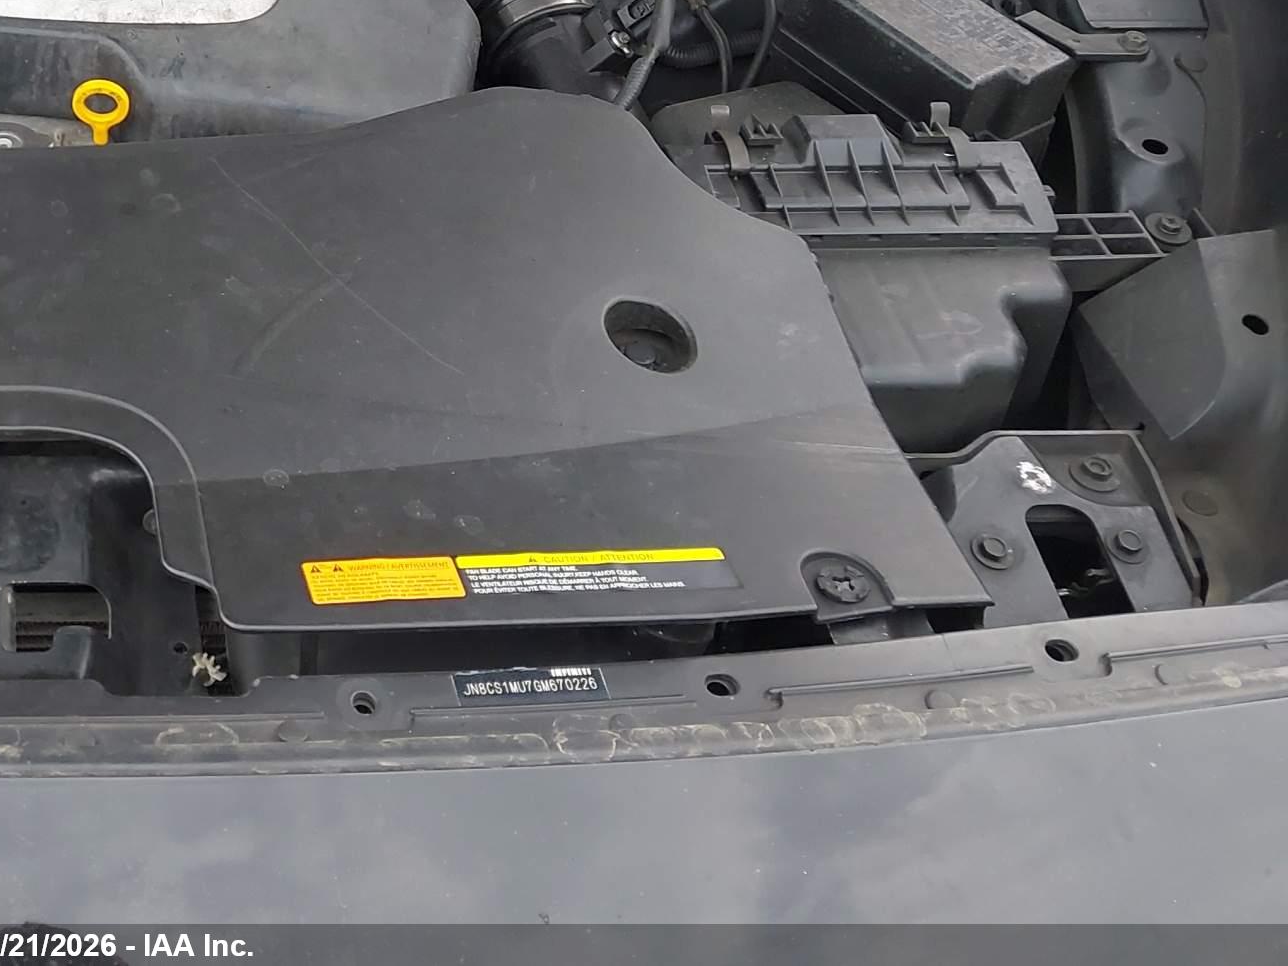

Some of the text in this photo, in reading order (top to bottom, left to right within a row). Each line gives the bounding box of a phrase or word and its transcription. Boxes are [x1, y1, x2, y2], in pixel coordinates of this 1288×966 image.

[543, 555, 588, 563] CAUTION
[600, 553, 655, 562] ATTENTION
[391, 561, 450, 570] AVERTISSEMENT
[464, 677, 598, 696] JN8CS1MU7GM670226
